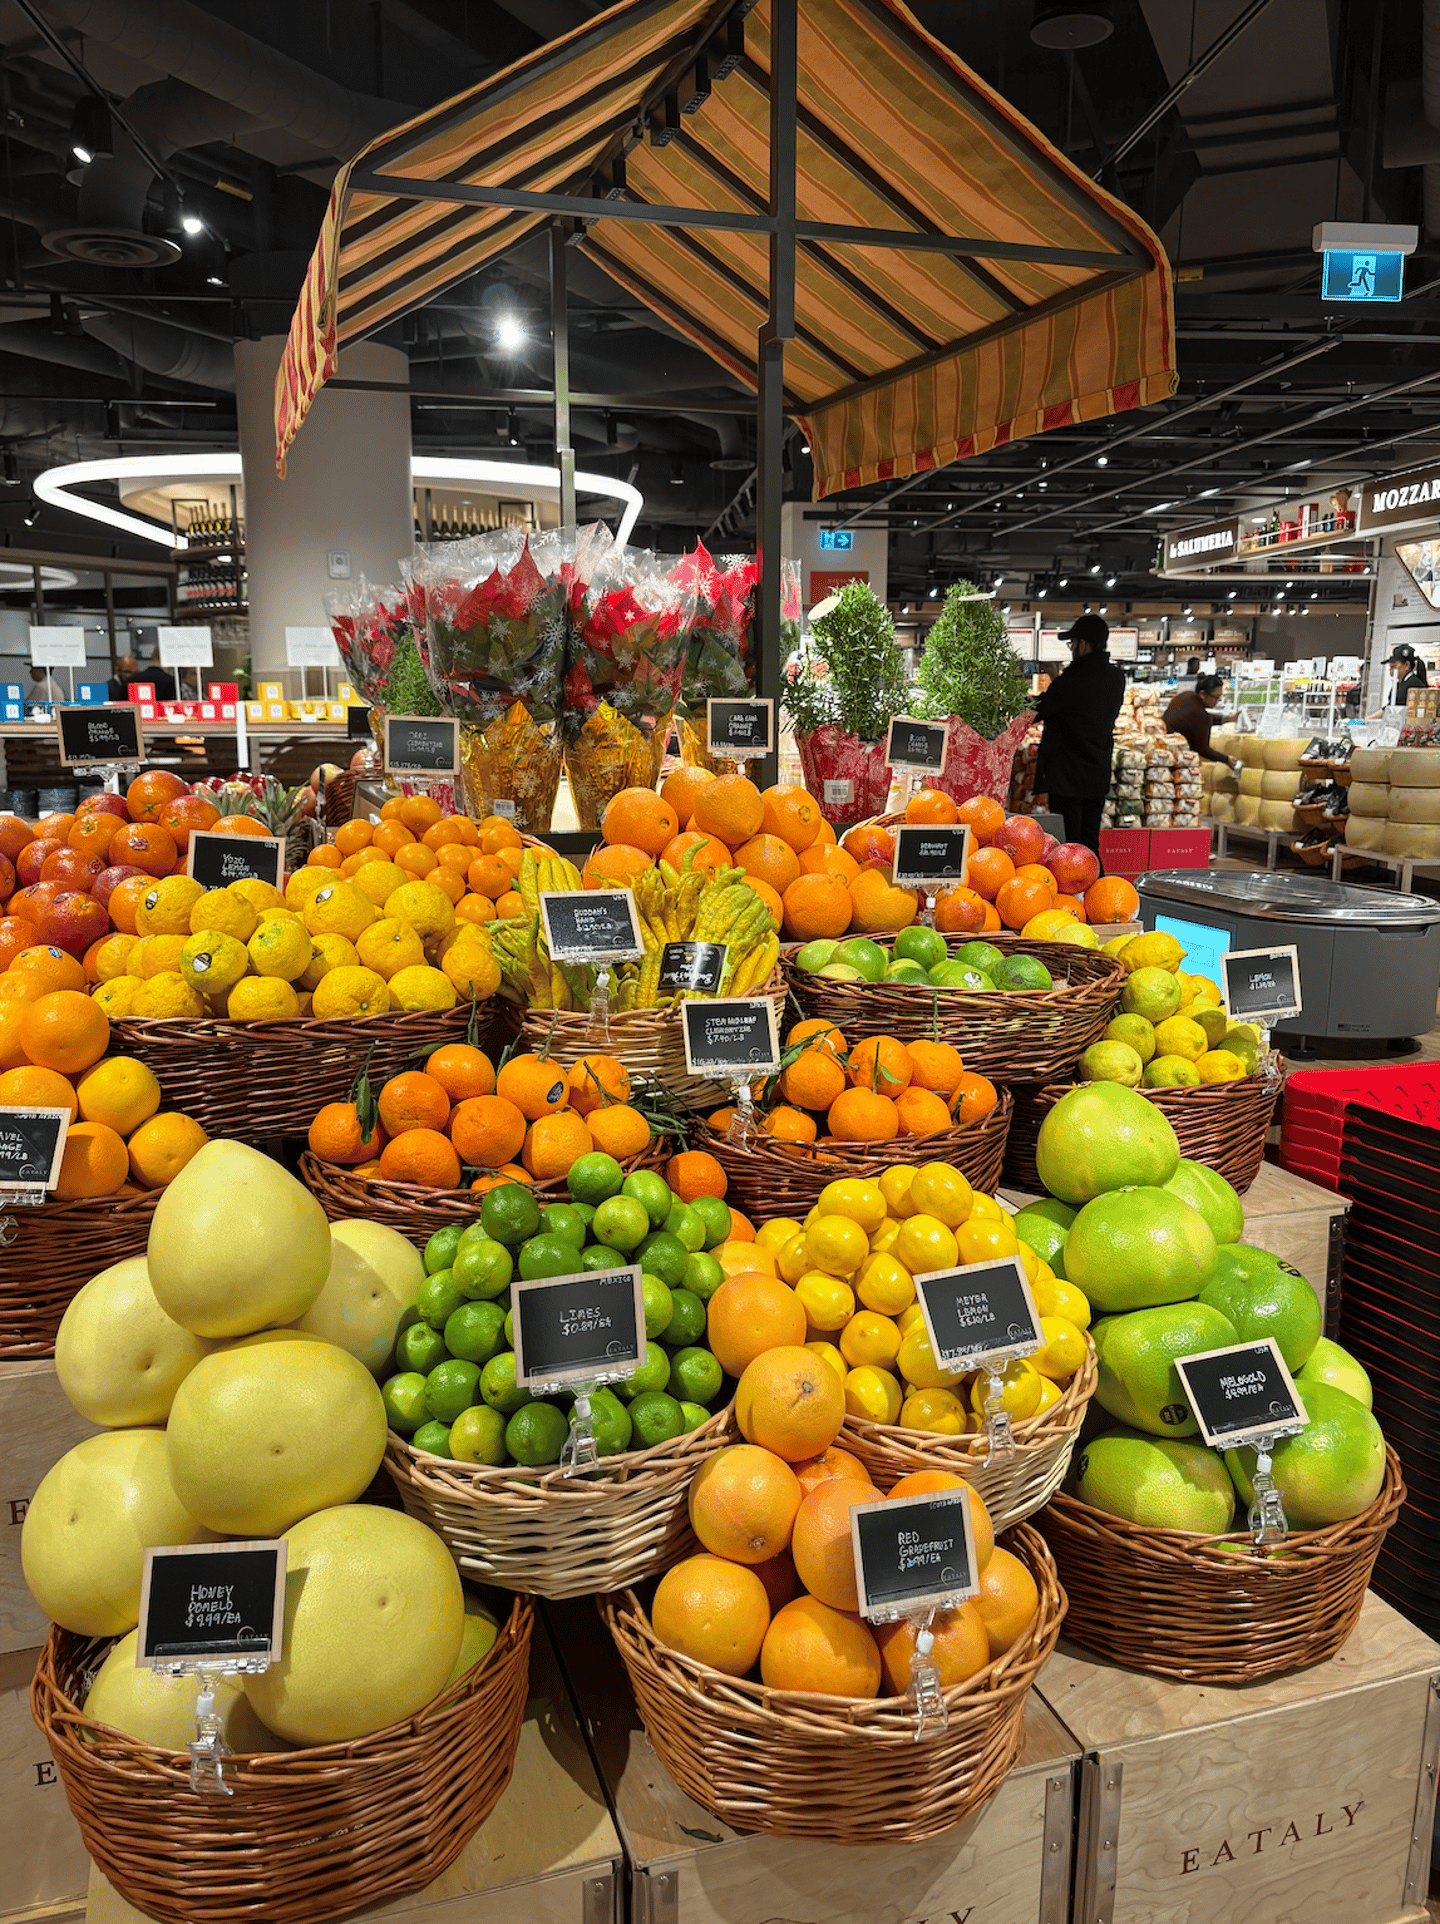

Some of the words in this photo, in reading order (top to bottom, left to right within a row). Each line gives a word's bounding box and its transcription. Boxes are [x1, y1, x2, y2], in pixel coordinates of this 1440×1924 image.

[1372, 479, 1440, 513] MOZZAR
[1178, 530, 1233, 557] SALUMERIA
[221, 863, 250, 872] LEMON
[599, 1275, 632, 1286] MEXICO
[956, 1292, 989, 1307] MEYER
[559, 1307, 601, 1323] LIMES
[957, 1304, 989, 1318] LEMON
[1254, 1346, 1269, 1354] USA
[1219, 1370, 1267, 1389] MELOGOLD
[898, 1531, 920, 1545] RED
[899, 1538, 954, 1558] GRAPEFRUIT
[191, 1584, 234, 1601] HONEY
[188, 1600, 234, 1614] POMELO
[32, 1760, 57, 1787] E
[1178, 1801, 1365, 1876] EATALY
